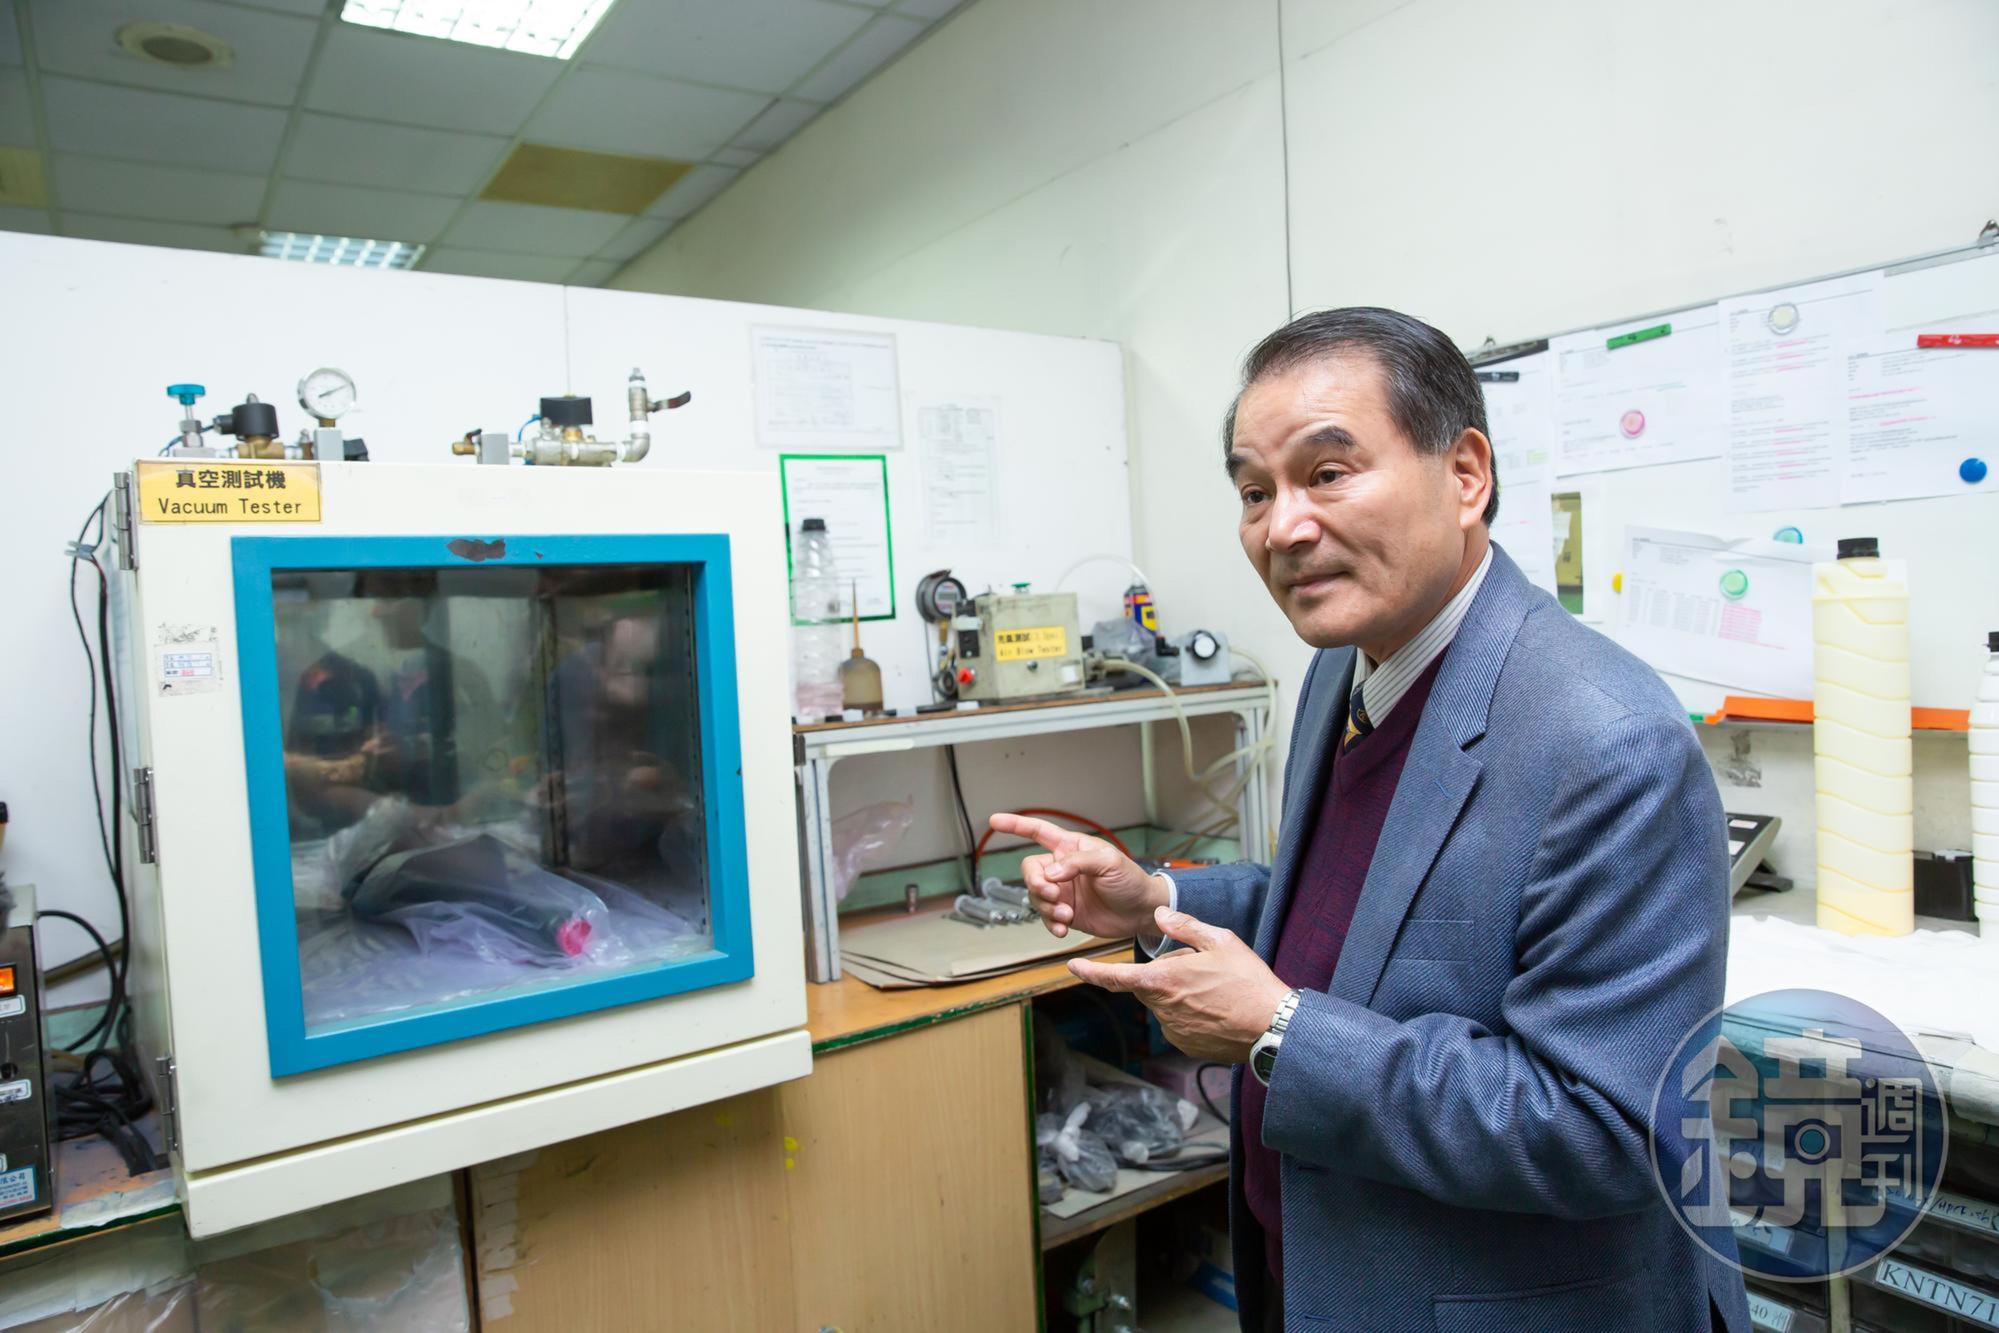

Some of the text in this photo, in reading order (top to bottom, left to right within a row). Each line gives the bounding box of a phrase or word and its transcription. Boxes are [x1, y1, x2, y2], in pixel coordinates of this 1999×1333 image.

[176, 469, 286, 489] 真空測試機
[158, 498, 302, 514] Vacuum Tester
